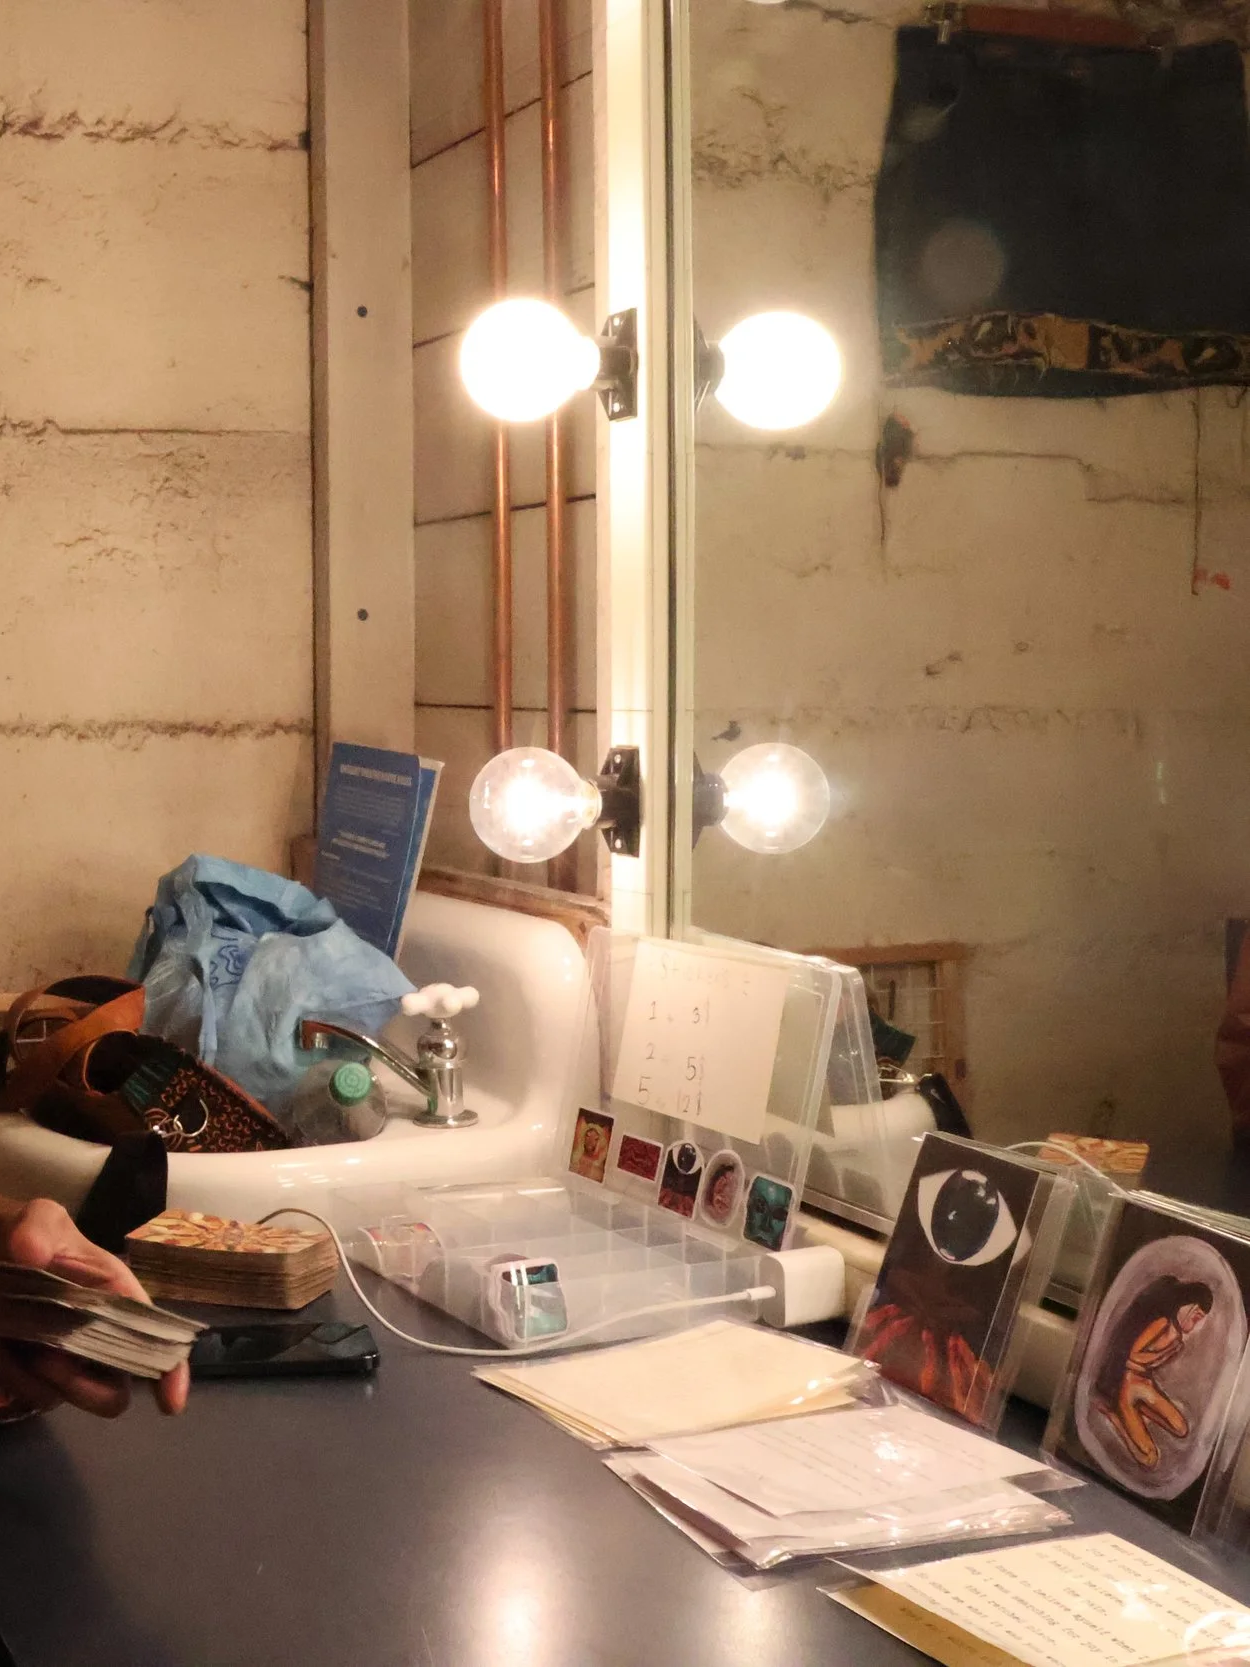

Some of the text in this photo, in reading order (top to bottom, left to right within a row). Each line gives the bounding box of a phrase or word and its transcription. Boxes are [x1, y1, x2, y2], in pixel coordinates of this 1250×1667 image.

[647, 1000, 658, 1021] 1
[645, 1041, 657, 1061] 2
[636, 1075, 652, 1106] 5
[1012, 1596, 1059, 1626] searching
[1061, 1627, 1081, 1639] for
[1080, 1641, 1102, 1653] joy
[1033, 1589, 1071, 1612] believe
[1073, 1614, 1110, 1635] myself
[1111, 1638, 1136, 1653] when
